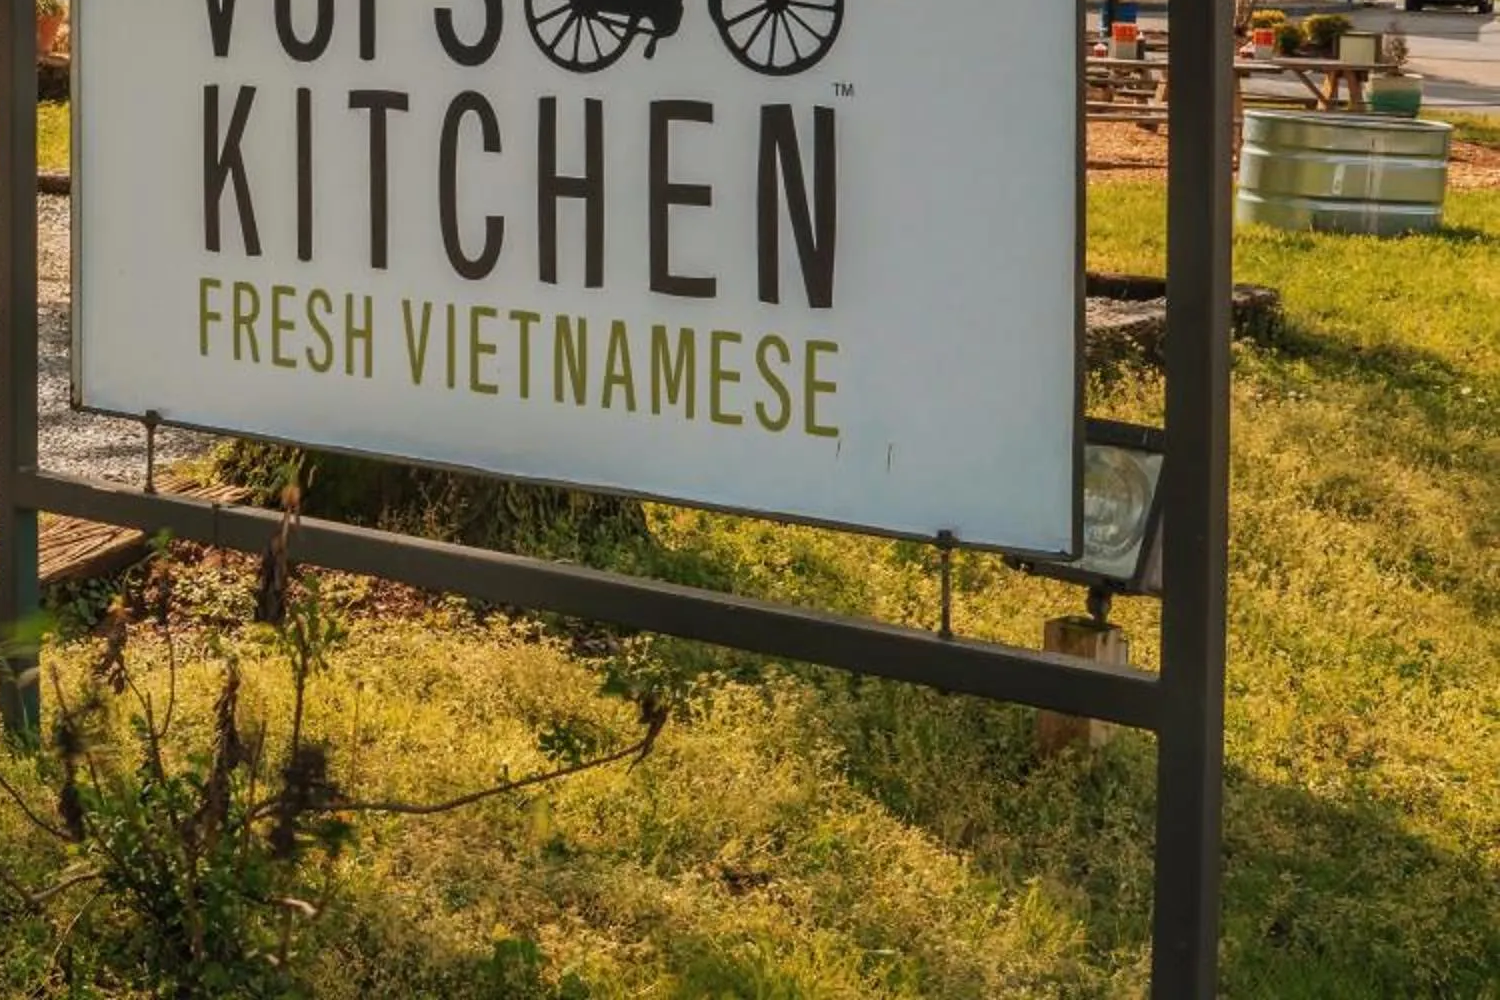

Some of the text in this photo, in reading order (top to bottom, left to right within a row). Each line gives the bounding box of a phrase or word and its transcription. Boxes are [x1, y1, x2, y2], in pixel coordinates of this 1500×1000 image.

[203, 82, 854, 309] KITCHEN TM
[199, 277, 839, 438] FRESH VIETNAMESE
